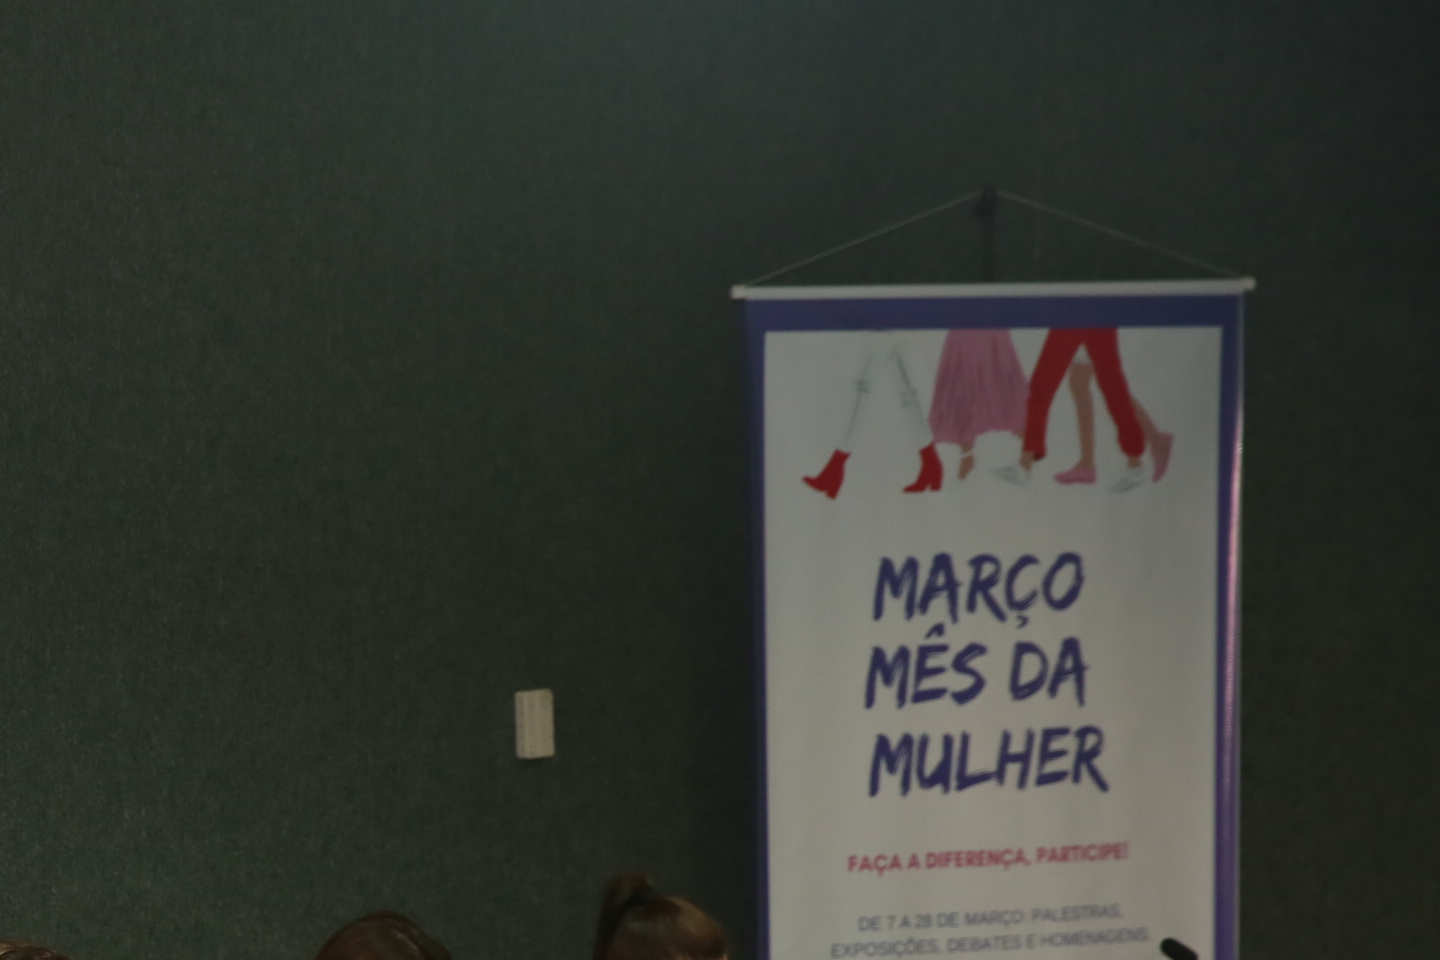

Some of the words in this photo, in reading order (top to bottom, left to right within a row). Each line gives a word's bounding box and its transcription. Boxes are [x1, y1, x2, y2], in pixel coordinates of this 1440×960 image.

[873, 552, 1085, 629] MARÇO
[864, 622, 988, 710] MÊS
[1009, 636, 1090, 708] DA
[868, 725, 1109, 798] MULHER
[847, 853, 903, 877] FAÇA
[907, 853, 921, 869] A
[858, 915, 881, 932] DE
[937, 911, 960, 928] DE
